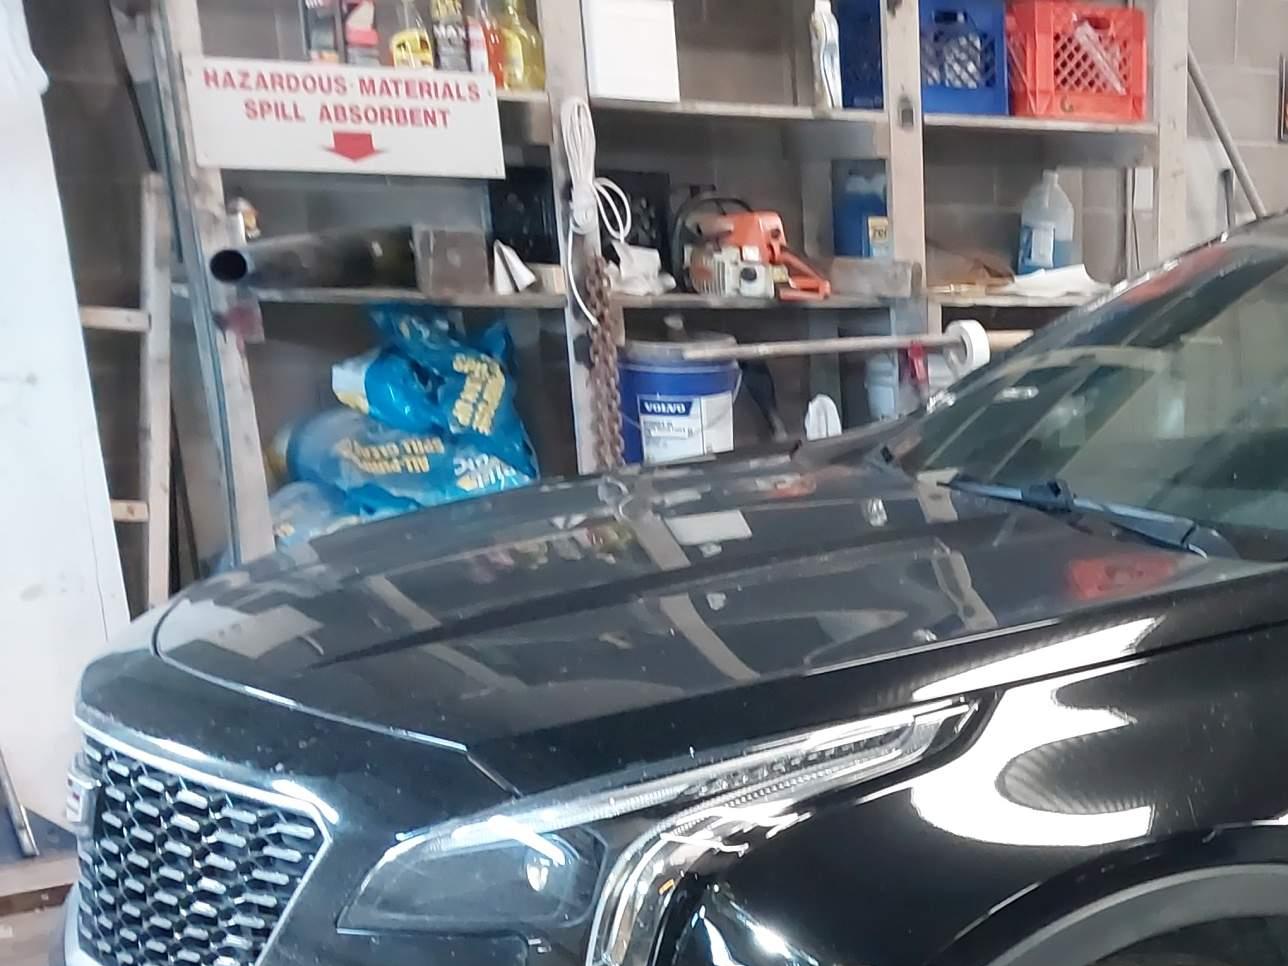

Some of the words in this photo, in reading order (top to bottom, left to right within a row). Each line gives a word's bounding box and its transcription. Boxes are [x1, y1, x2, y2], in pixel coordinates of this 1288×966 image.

[203, 68, 347, 95] HAZARDOUS
[358, 78, 481, 101] MATERIALS
[244, 98, 305, 122] SPILL
[319, 103, 450, 128] ABSORBENT
[643, 401, 686, 414] VOLVO
